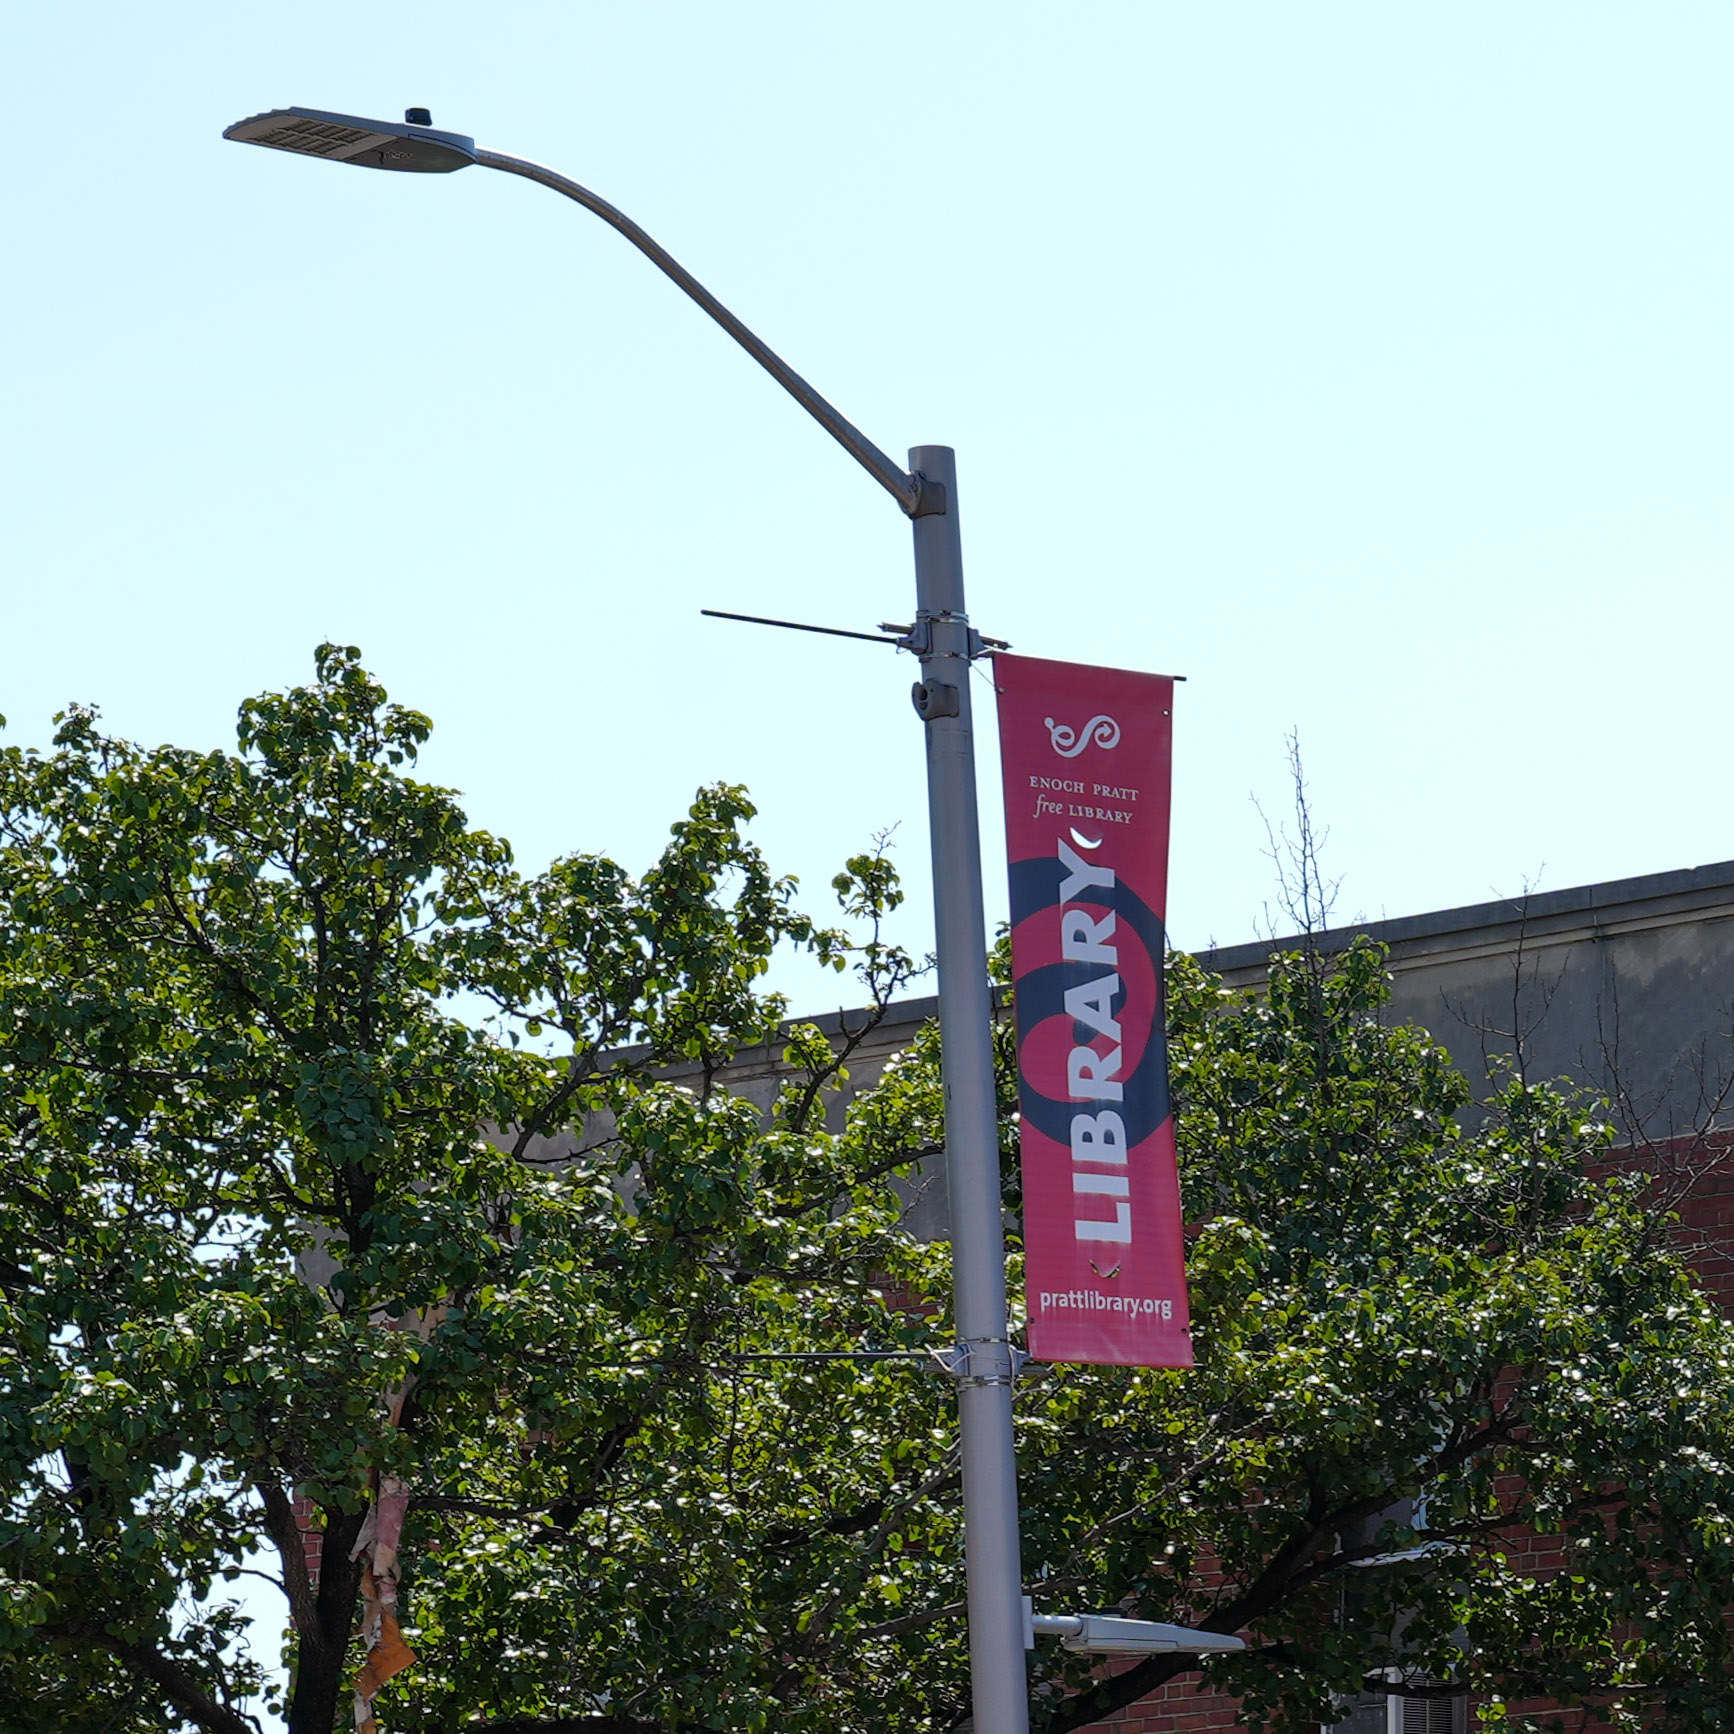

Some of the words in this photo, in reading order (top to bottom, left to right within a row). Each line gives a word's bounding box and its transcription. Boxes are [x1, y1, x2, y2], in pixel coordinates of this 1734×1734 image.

[1029, 775, 1085, 794] ENOCH
[1093, 783, 1139, 801] PRATT
[1034, 794, 1064, 818] free
[1069, 804, 1133, 824] LIBRARY
[1058, 836, 1132, 1244] LIBRARY
[1040, 1290, 1172, 1319] prattlibrary.org
